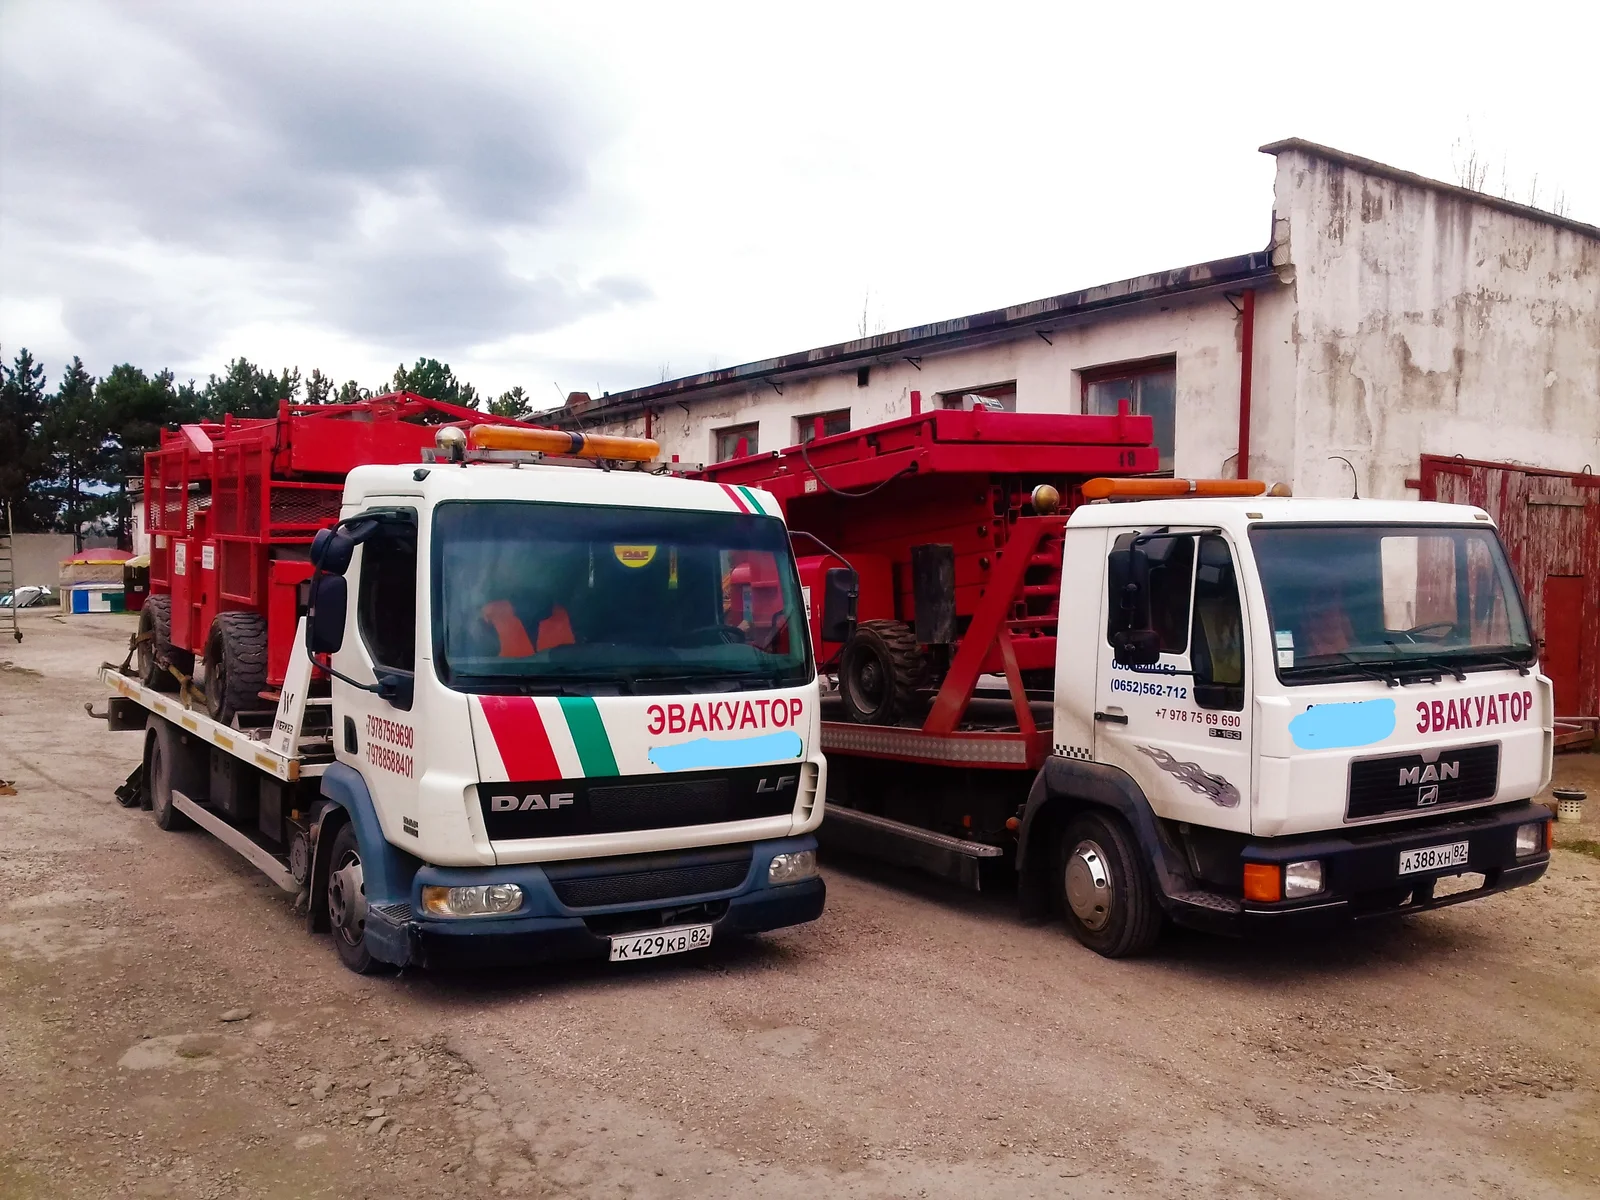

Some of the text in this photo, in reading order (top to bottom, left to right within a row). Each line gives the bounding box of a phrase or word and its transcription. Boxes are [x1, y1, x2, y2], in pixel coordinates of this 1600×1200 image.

[1111, 679, 1187, 699] (0652)562-712
[647, 698, 803, 735] ЭВАКУАТОР
[1169, 710, 1187, 721] 978
[1190, 712, 1203, 723] 75
[1205, 714, 1218, 725] 69
[1221, 715, 1241, 727] 690
[1416, 691, 1533, 734] ЭВАКУАТОР
[1399, 761, 1460, 786] MAN
[756, 775, 796, 793] LF
[491, 793, 574, 812] DAF
[1453, 844, 1465, 858] 82
[691, 928, 707, 943] 82
